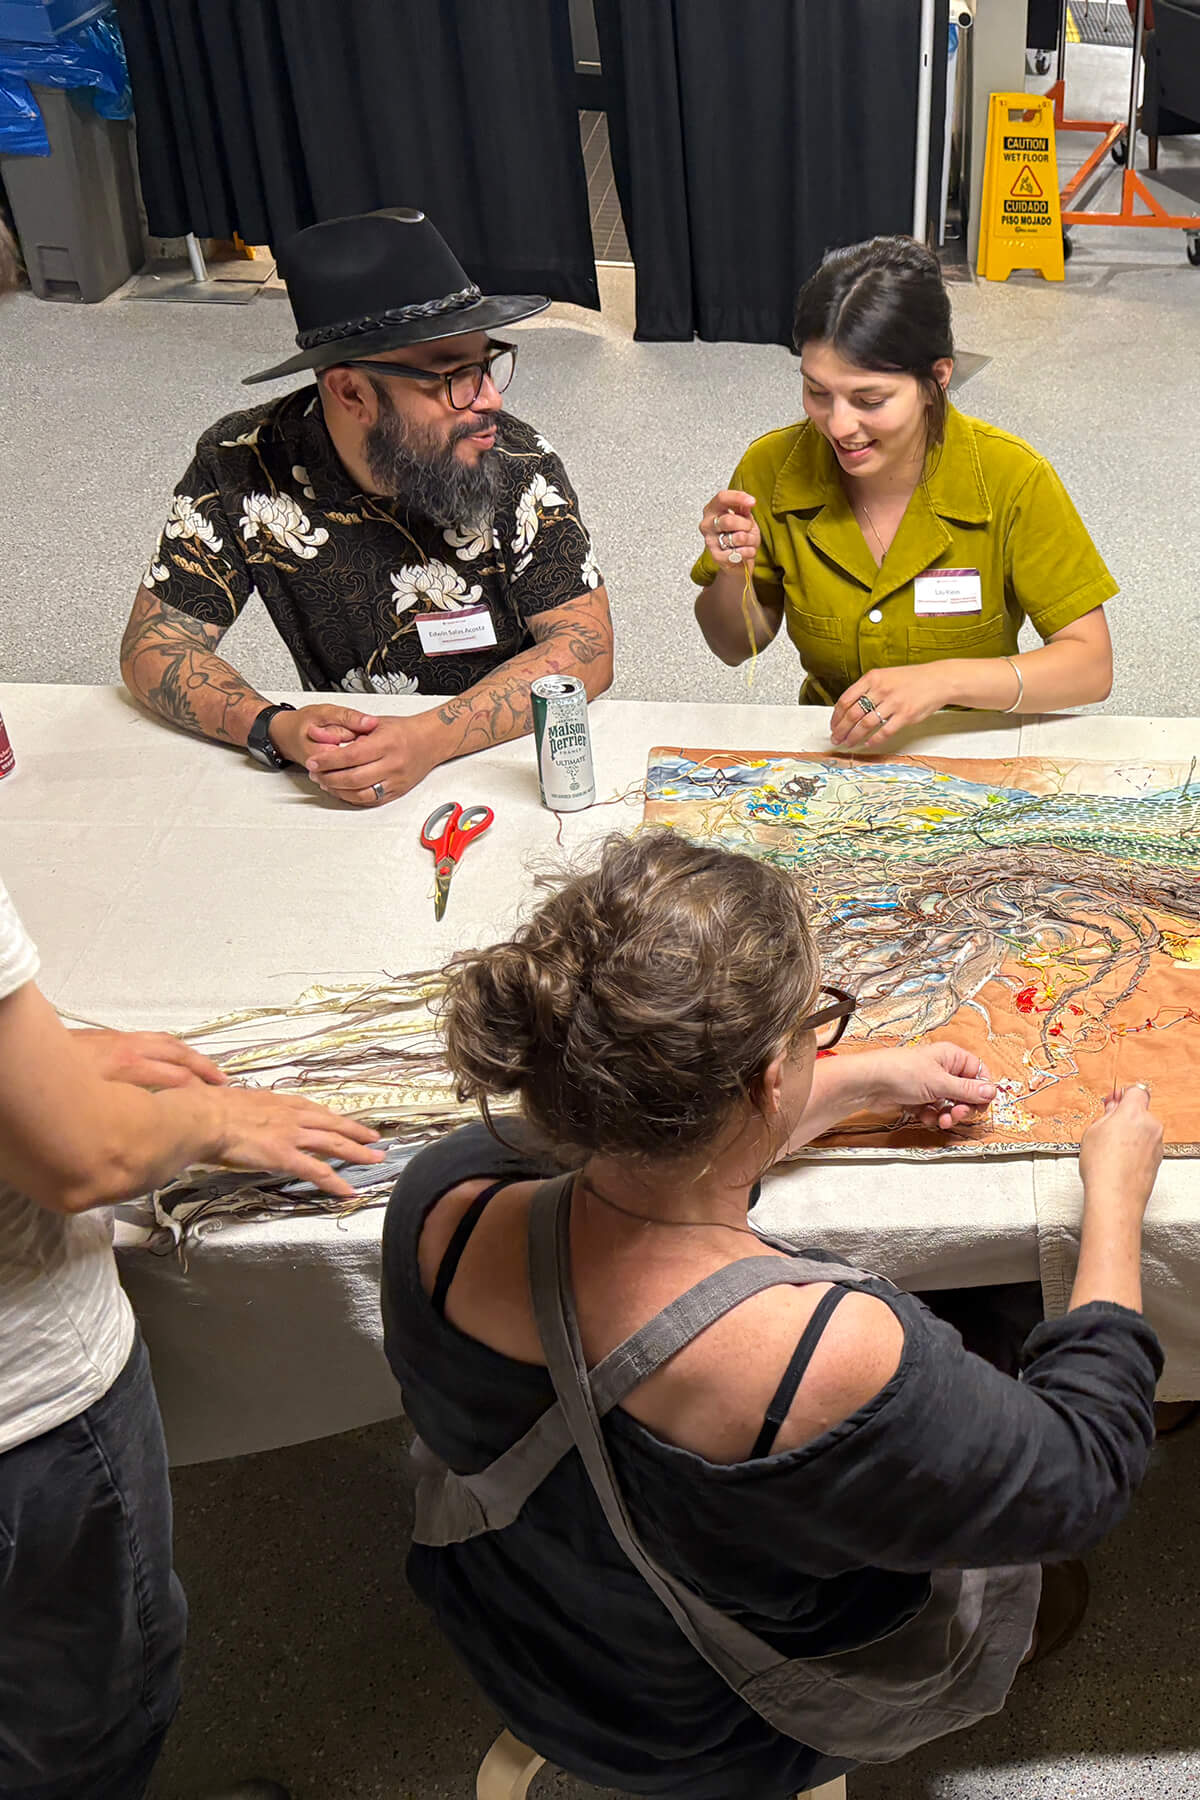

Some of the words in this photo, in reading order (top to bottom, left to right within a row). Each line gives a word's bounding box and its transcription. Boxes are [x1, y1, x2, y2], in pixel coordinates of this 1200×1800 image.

[1007, 138, 1046, 150] CAUTION
[1004, 153, 1021, 162] WET
[1023, 153, 1049, 163] FLOOR
[1006, 201, 1047, 212] CUIDADO
[1002, 216, 1019, 225] PISO
[1020, 216, 1052, 226] MOJADO
[465, 626, 485, 634] Acosta
[549, 724, 586, 739] Maison
[555, 756, 586, 766] ULTIMATE
